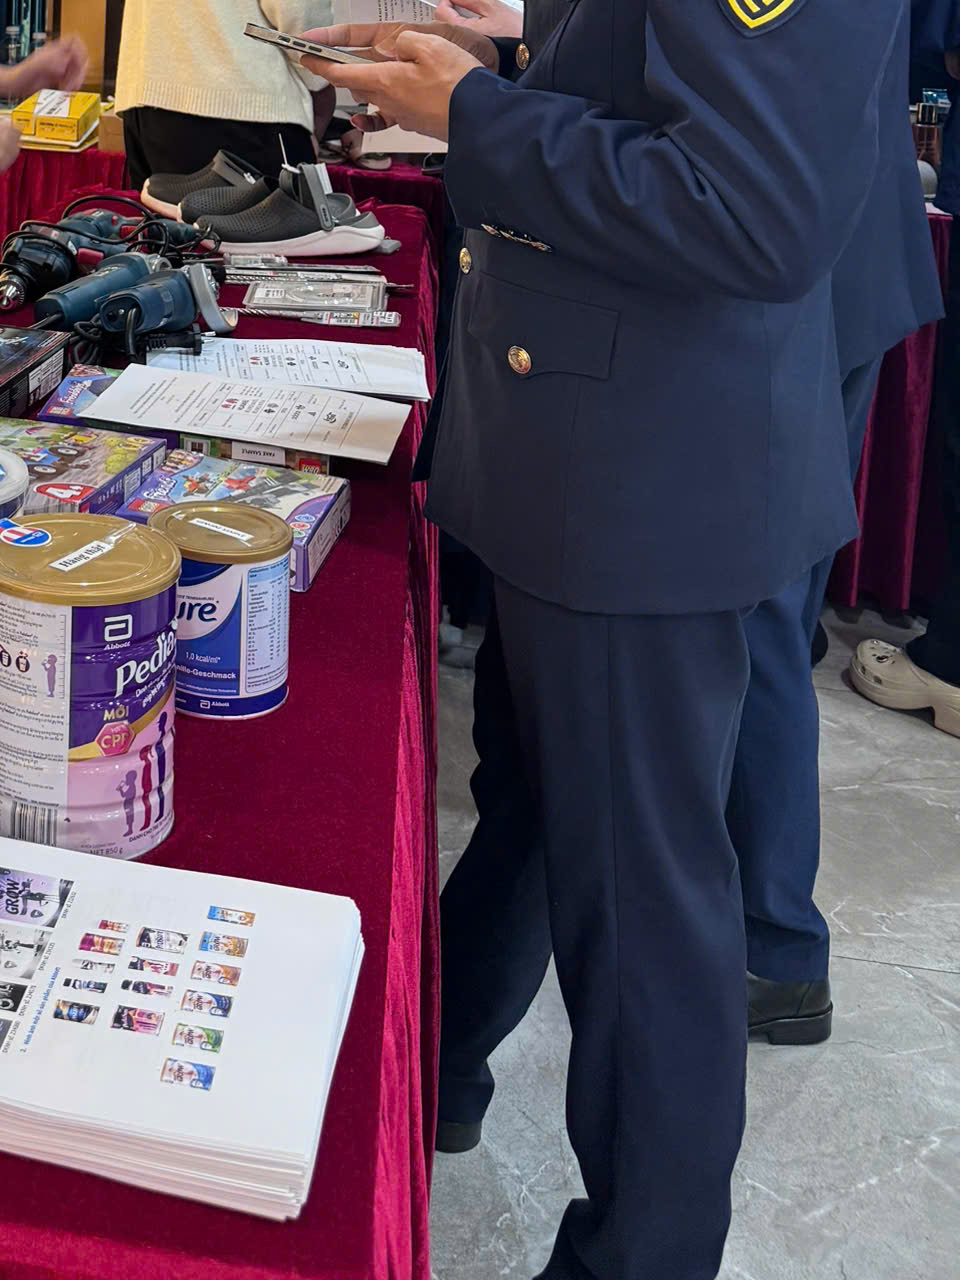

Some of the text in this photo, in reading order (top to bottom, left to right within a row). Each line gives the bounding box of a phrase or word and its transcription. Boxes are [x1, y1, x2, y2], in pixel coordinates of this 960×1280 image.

[104, 641, 131, 650] Abbott
[106, 847, 118, 855] 850
[5, 878, 19, 915] GROW
